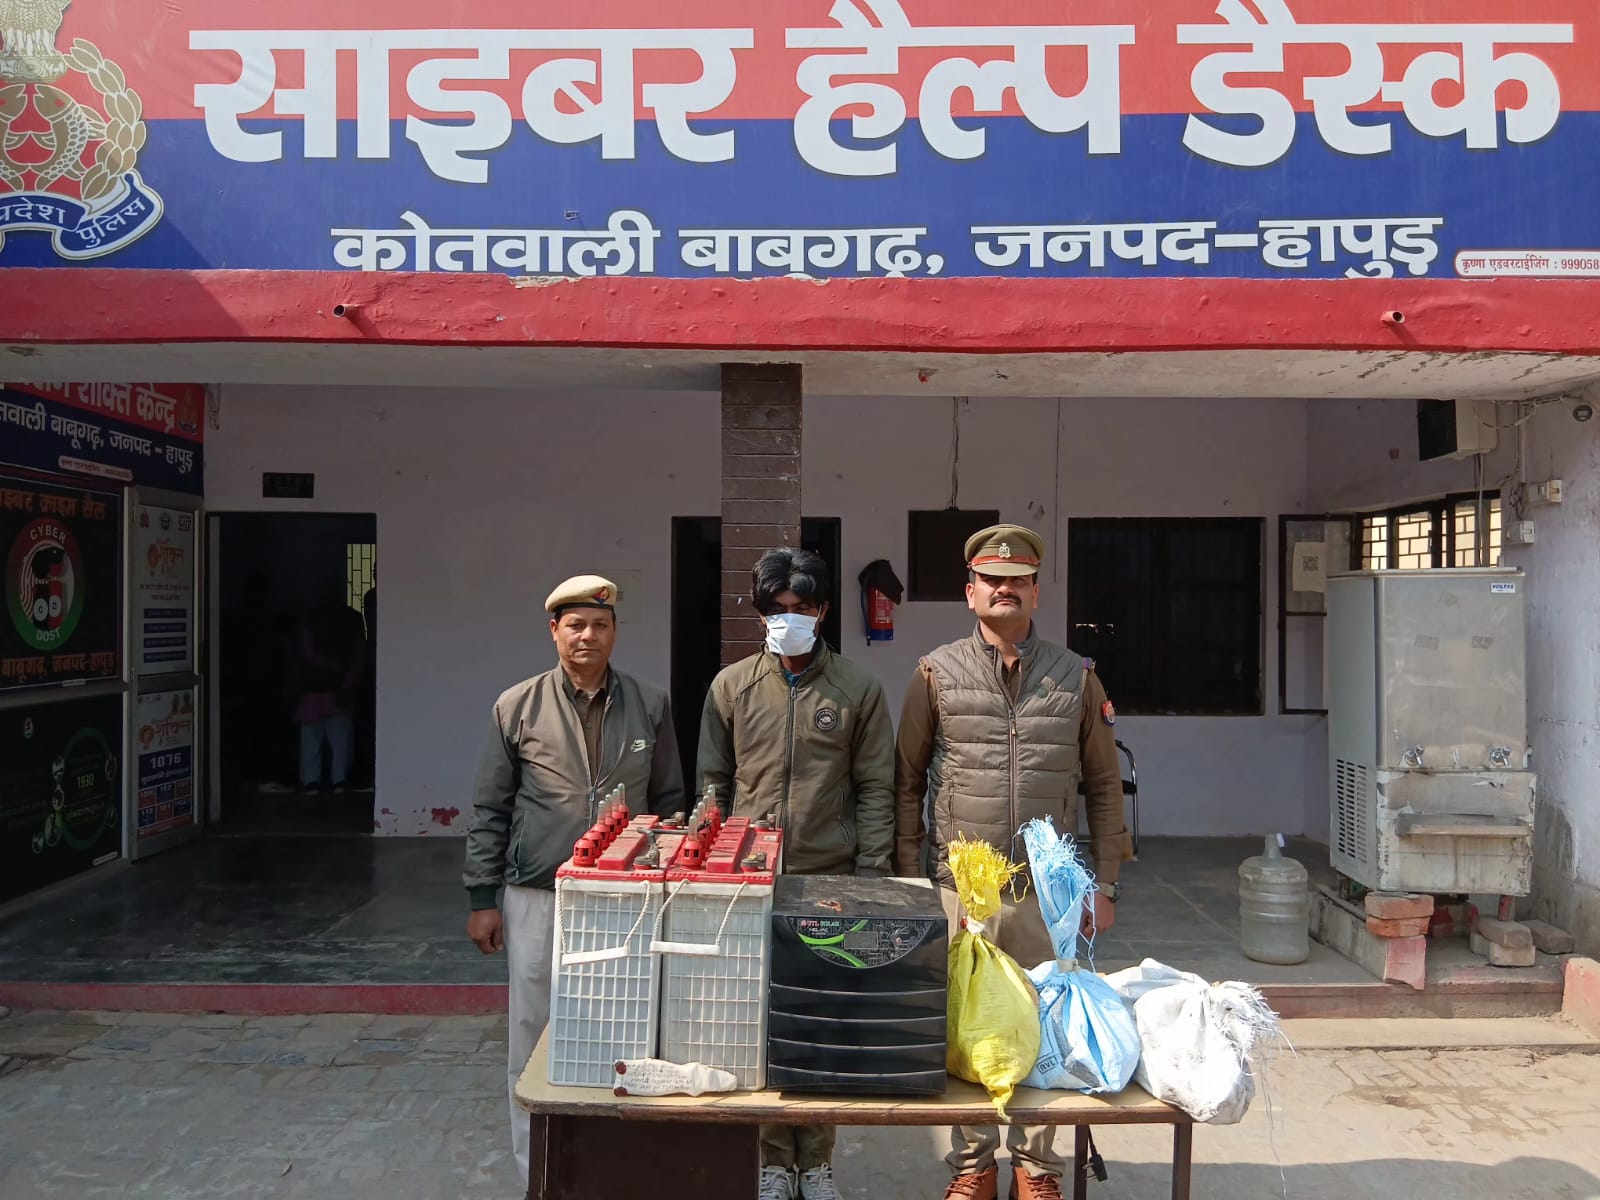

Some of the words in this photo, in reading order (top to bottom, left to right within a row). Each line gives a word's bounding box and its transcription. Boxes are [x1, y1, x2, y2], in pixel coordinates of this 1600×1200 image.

[189, 28, 754, 184] साइबर
[784, 0, 1136, 176] हैल्प
[1176, 0, 1575, 167] डैस्क
[76, 197, 146, 248] पुलिस
[331, 210, 661, 277] कोतवाली
[679, 227, 944, 278] बाबगढ़,
[1461, 258, 1486, 273] कृष्णा
[108, 430, 152, 457] जनपद
[30, 524, 67, 545] CYBER
[150, 752, 182, 769] 1076
[76, 772, 95, 791] 1930
